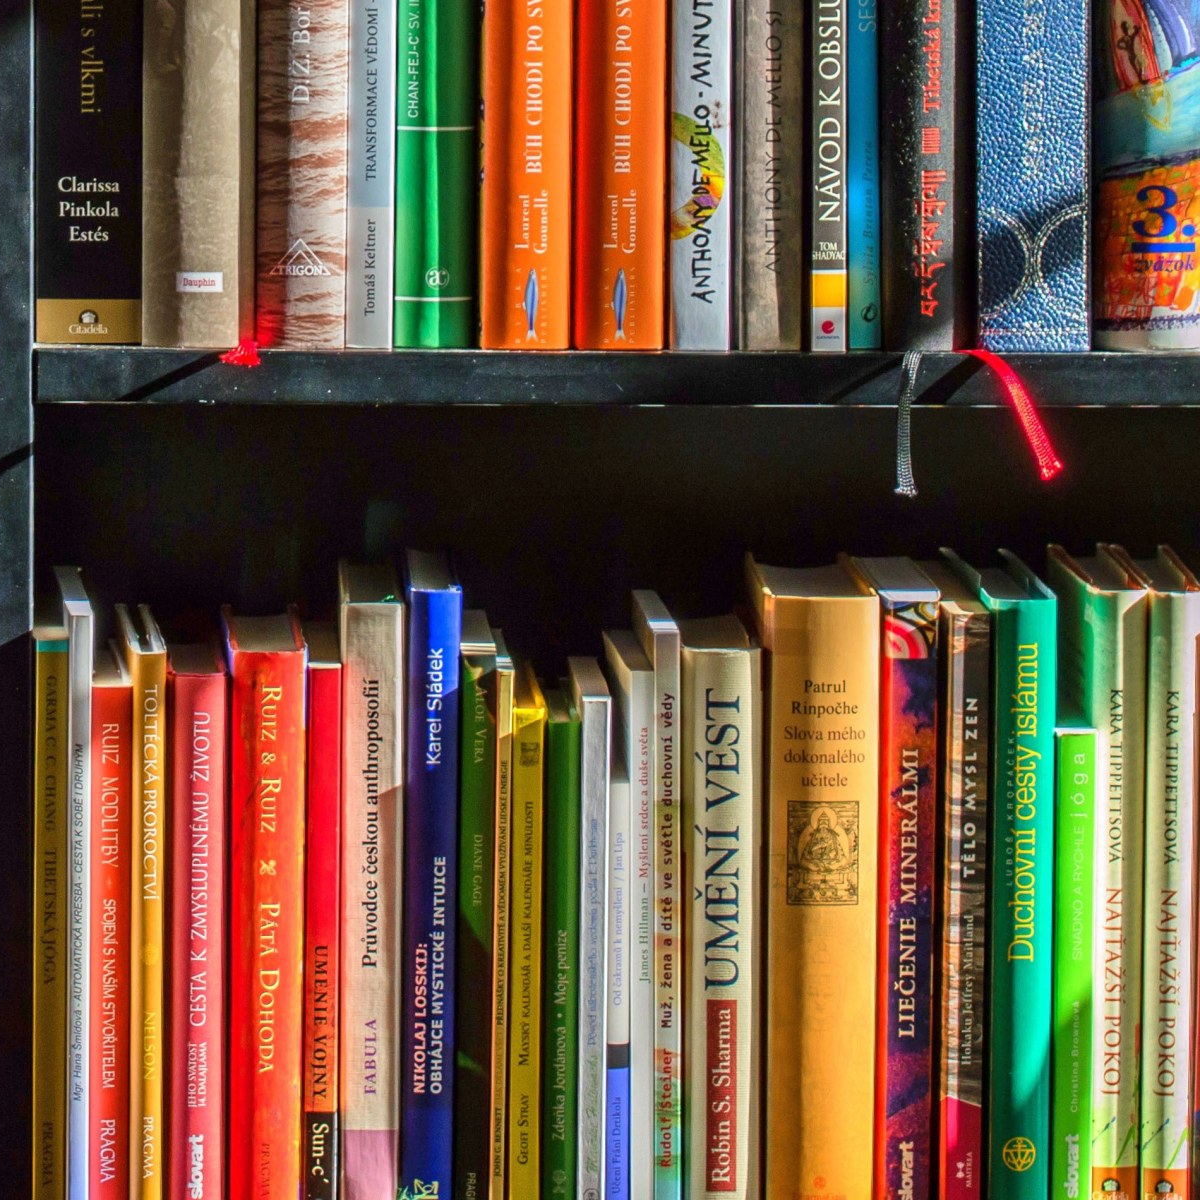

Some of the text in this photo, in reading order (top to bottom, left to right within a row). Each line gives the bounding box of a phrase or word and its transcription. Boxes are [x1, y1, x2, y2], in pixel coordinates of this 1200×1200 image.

[82, 27, 96, 37] s
[293, 7, 311, 44] Bor
[527, 25, 544, 52] PO
[80, 45, 103, 112] vlkmi
[363, 7, 379, 181] TRANSFORMACE VĚDOMÍ
[525, 60, 544, 125] CHODÍ
[818, 86, 841, 106] K
[921, 28, 941, 112] Tibetská
[57, 176, 120, 193] Clarissa
[524, 134, 543, 173] BŮH
[815, 117, 841, 222] NÁVOD
[58, 201, 120, 217] Pinkola
[68, 225, 109, 242] Estés
[183, 277, 216, 287] Dauphin
[425, 648, 444, 765] Karel Sládek
[791, 701, 858, 718] Rinpočhe
[803, 679, 846, 694] Patrul
[1007, 643, 1041, 962] Duchovní cesty islámu
[1108, 689, 1124, 863] KARA TIPPETTSOVÁ
[361, 679, 383, 968] Průvodce českou anthroposofií
[695, 688, 740, 990] UMĚNÍ VÉST
[188, 711, 210, 1026] CESTA K ZMYSLUPLNÉMU ŽIVOTU
[894, 748, 919, 1038] LIEČENIE MINERÁLMI
[713, 1008, 732, 1183] Robin S. Sharma
